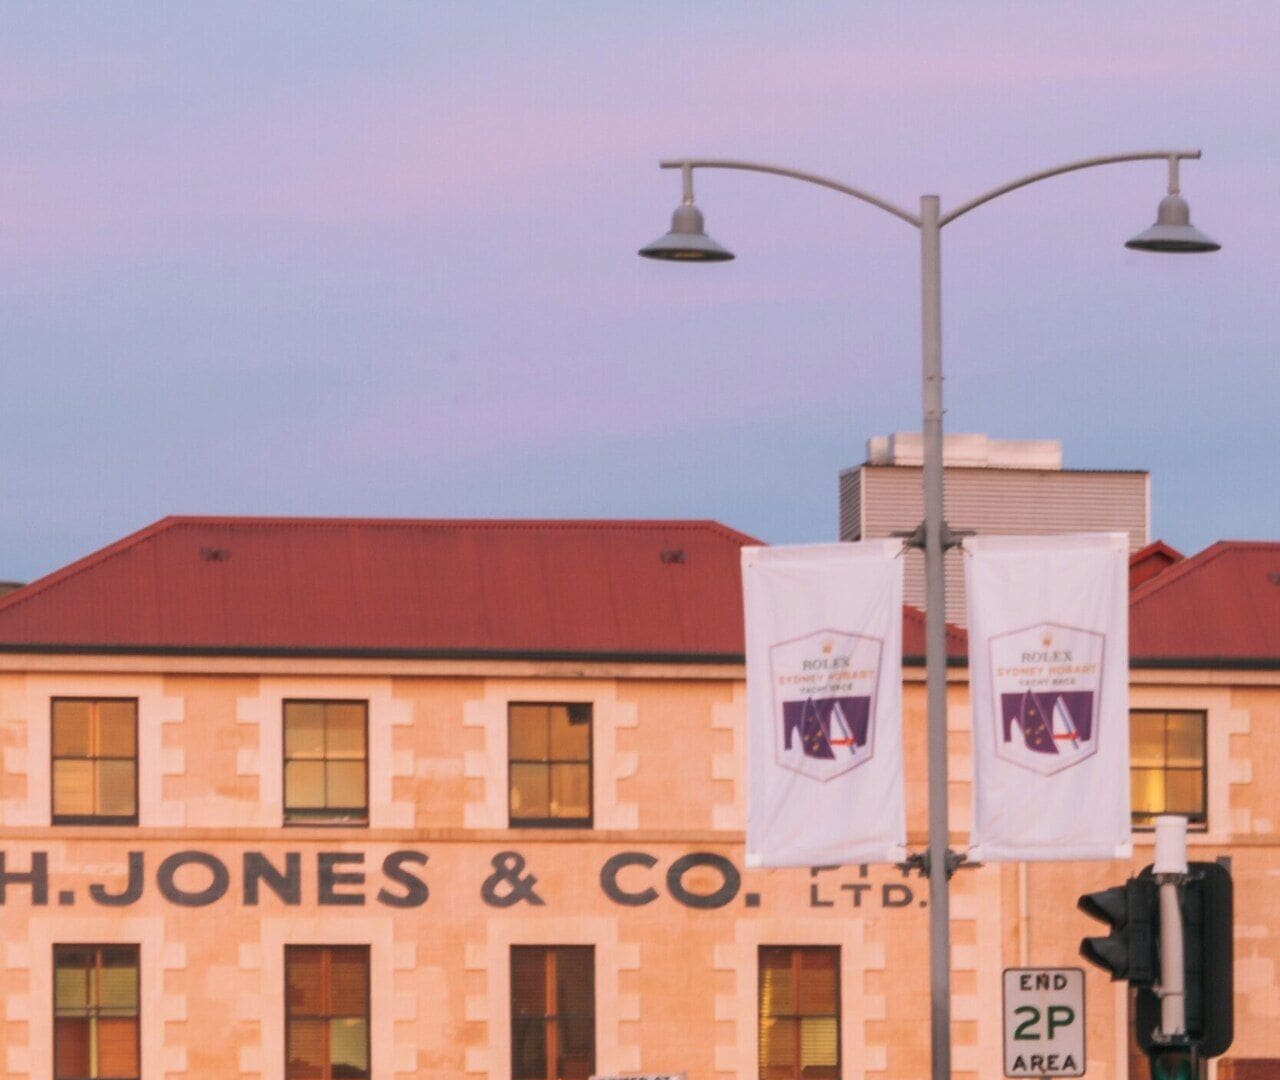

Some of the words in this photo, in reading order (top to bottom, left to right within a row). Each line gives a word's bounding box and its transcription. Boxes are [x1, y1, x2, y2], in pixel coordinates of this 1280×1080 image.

[802, 656, 851, 671] ROLEX
[1021, 651, 1074, 663] ROLEX
[480, 850, 547, 909] &
[599, 850, 762, 910] CO.
[810, 883, 928, 908] LTD.
[1019, 974, 1067, 991] END
[1013, 1005, 1076, 1041] 2P
[1011, 1054, 1077, 1071] AREA
